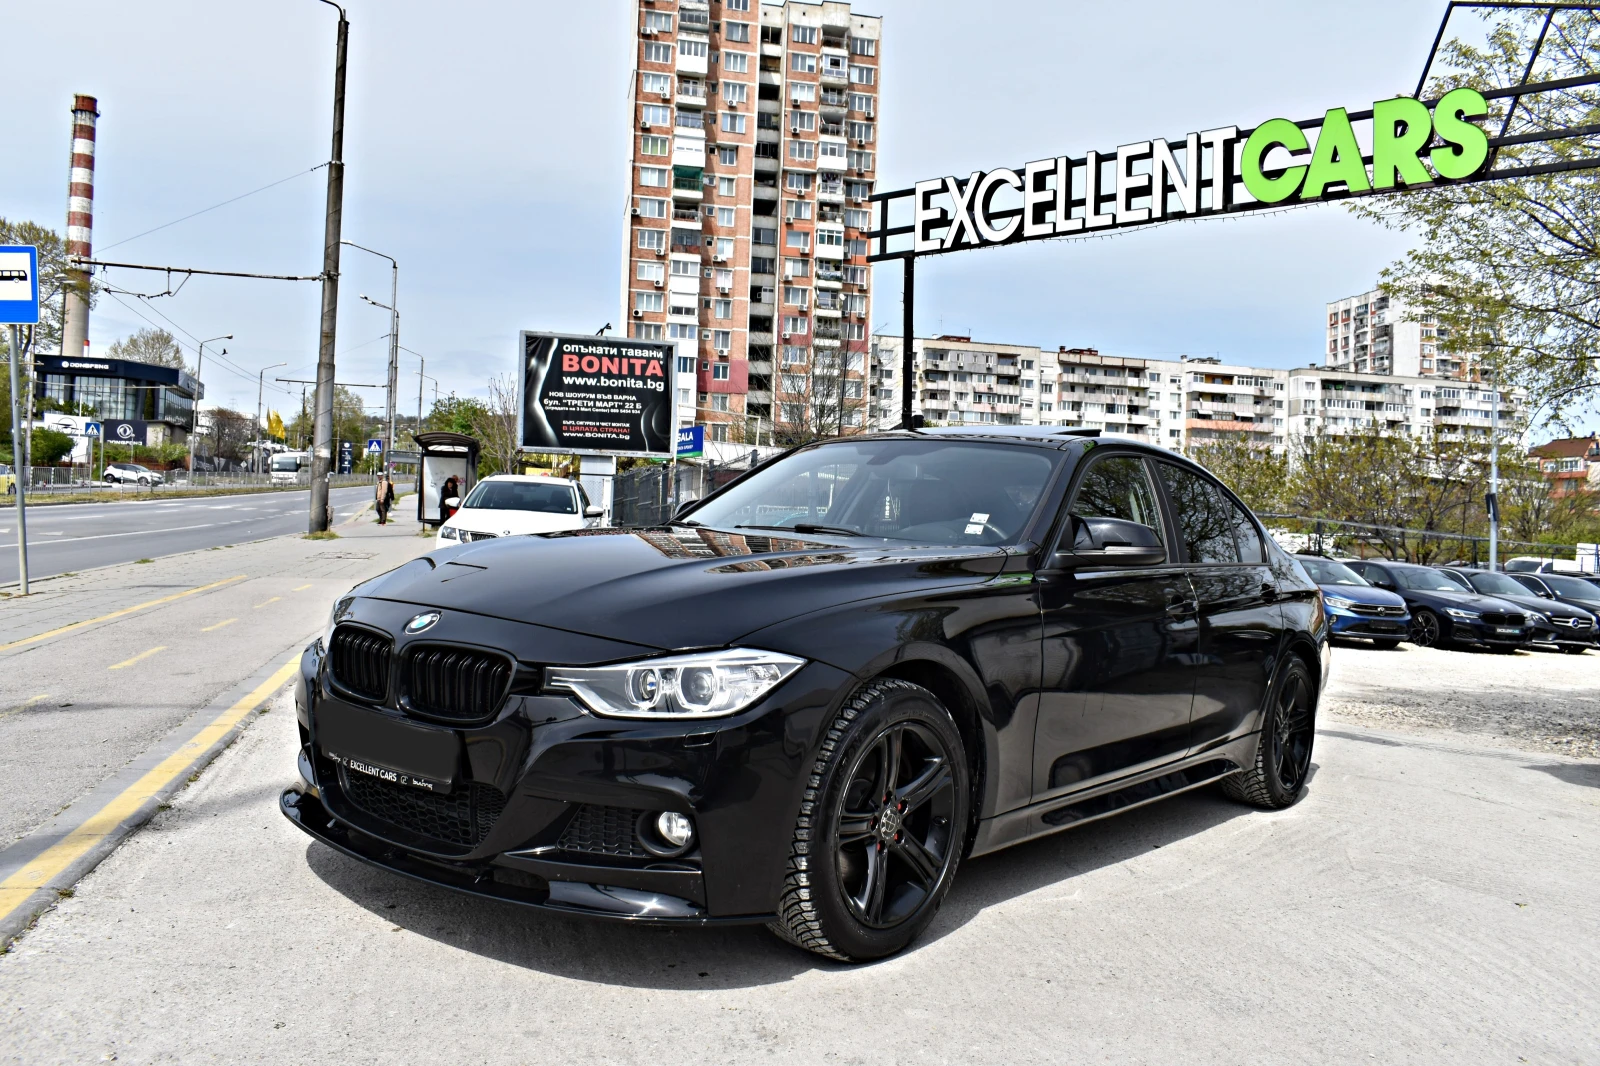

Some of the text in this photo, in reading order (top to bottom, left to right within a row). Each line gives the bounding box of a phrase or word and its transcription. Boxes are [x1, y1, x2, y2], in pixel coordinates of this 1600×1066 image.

[563, 344, 663, 358] опънати тавани
[70, 362, 110, 370] DONGFENG
[562, 354, 664, 376] BONITA
[563, 376, 665, 391] www.bonita.bg
[543, 398, 561, 406] бул.
[563, 432, 630, 440] www.BONITA.bg
[350, 759, 380, 777] EXCELLENT
[379, 769, 398, 782] CARS
